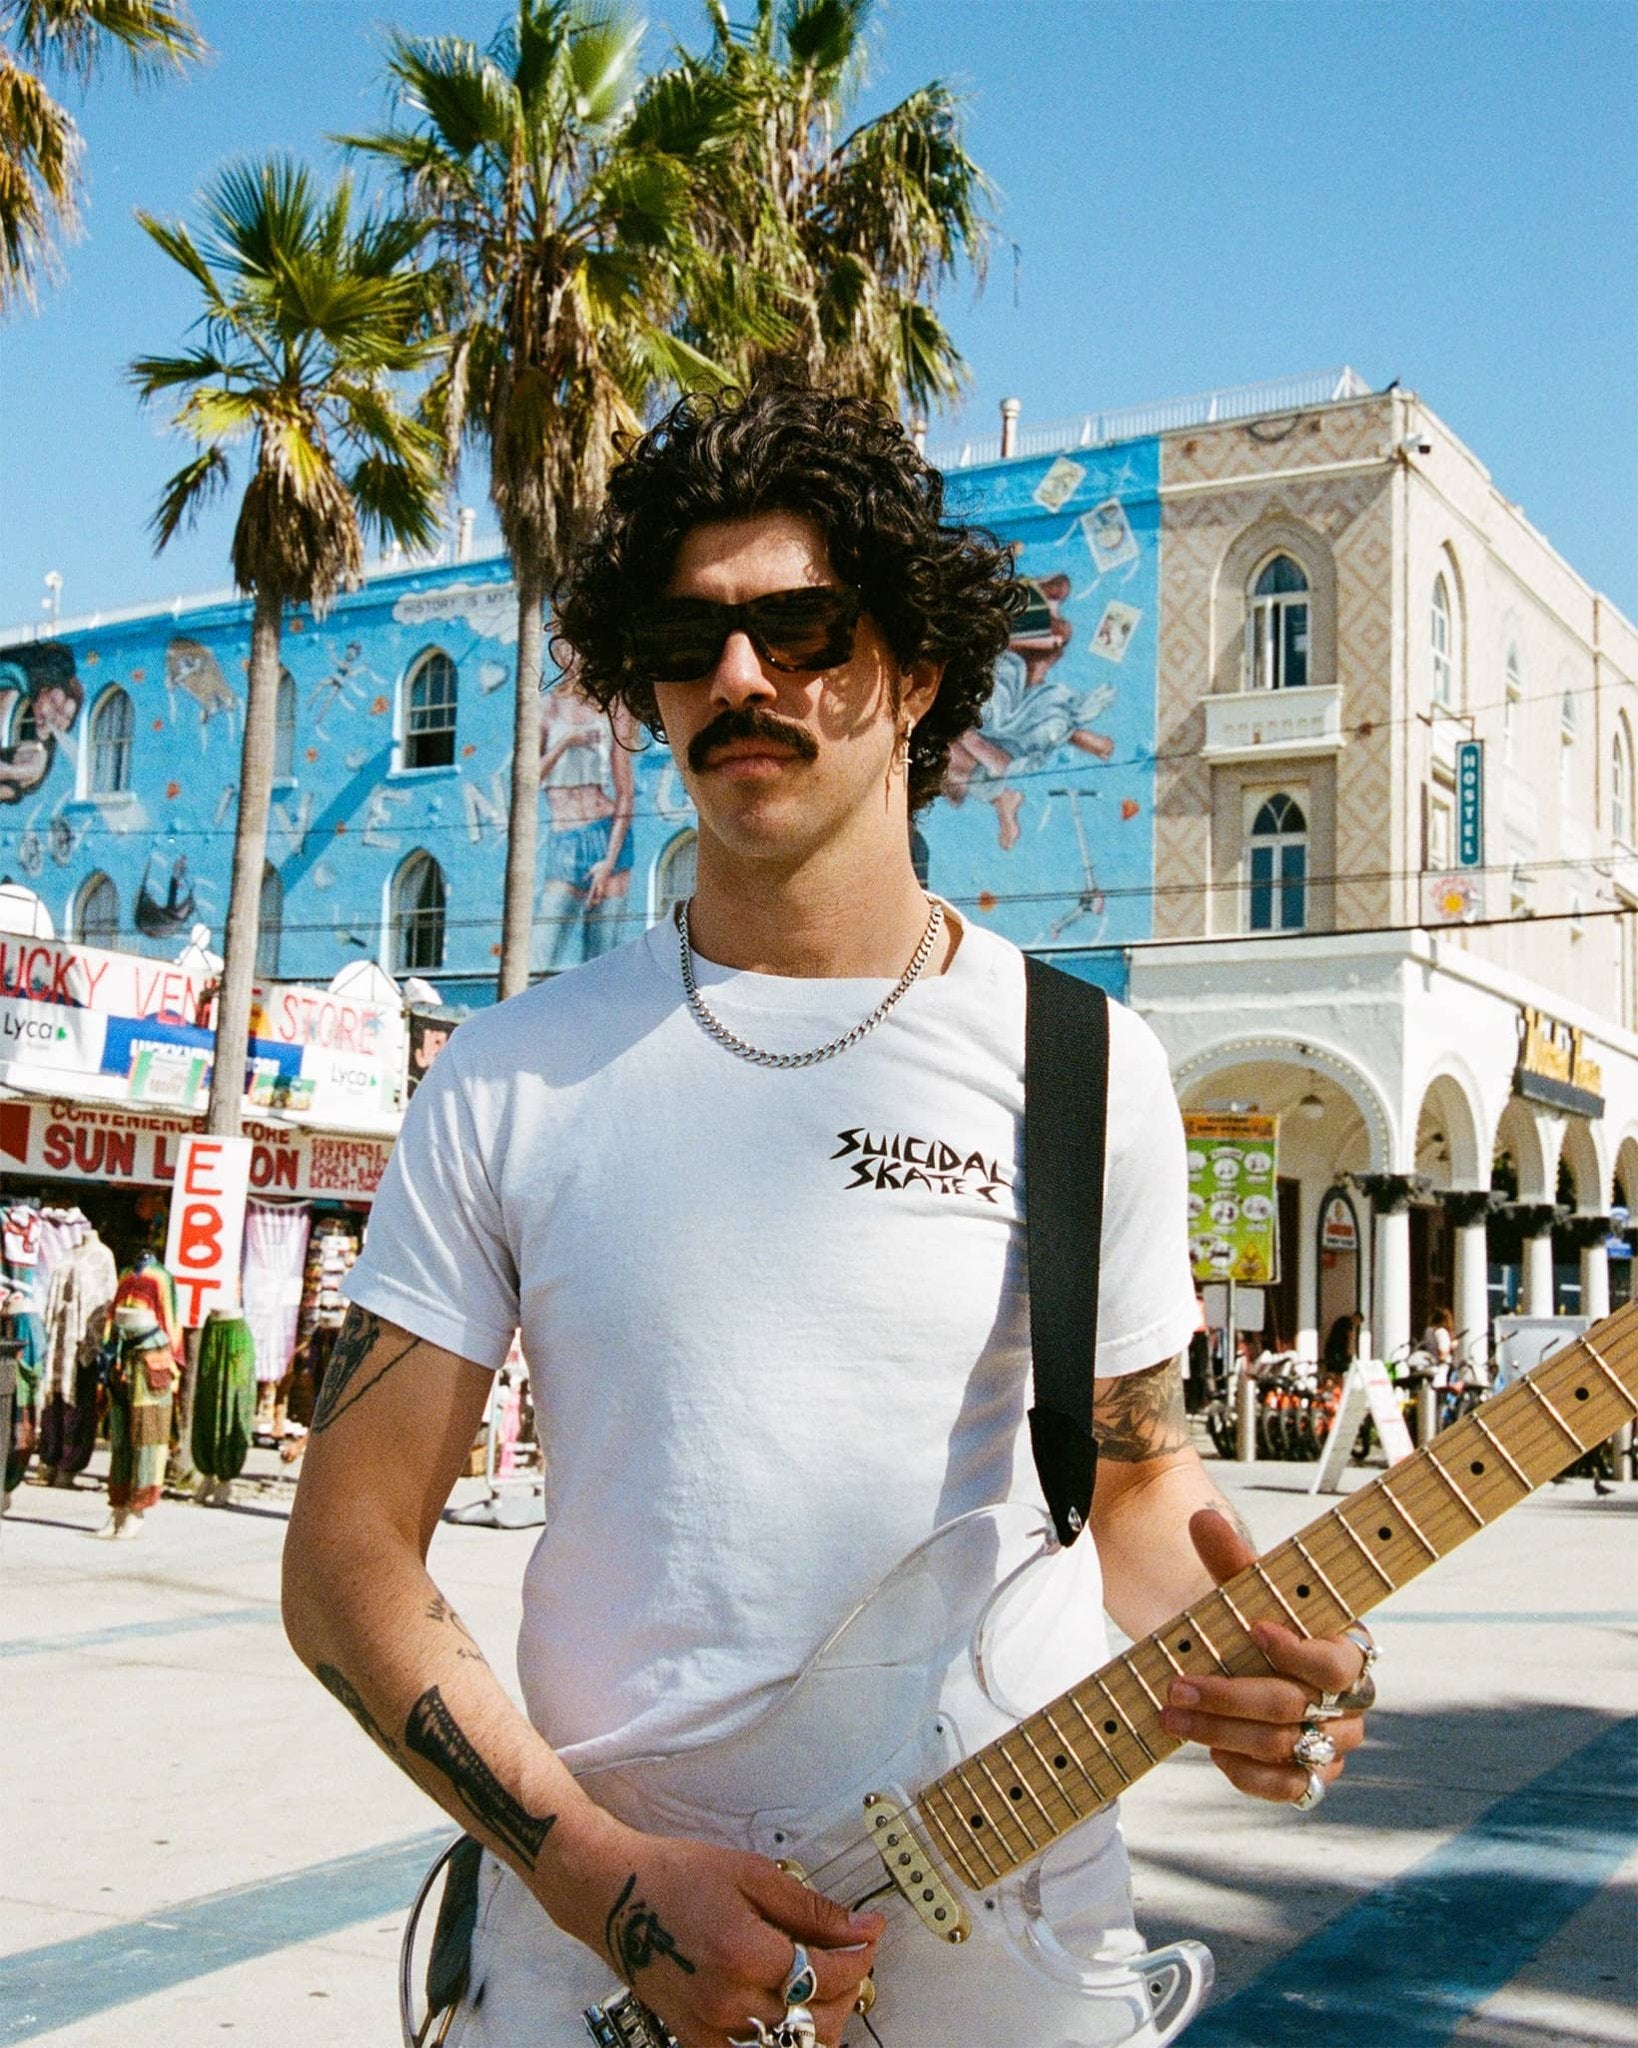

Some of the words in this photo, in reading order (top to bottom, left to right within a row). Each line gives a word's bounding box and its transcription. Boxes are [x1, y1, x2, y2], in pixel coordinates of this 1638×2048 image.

[1462, 753, 1476, 855] HOSTEL
[4, 1012, 53, 1040] Lyca
[279, 993, 377, 1056] STORE
[330, 1062, 368, 1087] Lyca
[43, 1123, 137, 1176] SUN
[829, 1127, 1015, 1190] SUICIDAL
[844, 1157, 1000, 1204] SKATES
[174, 1141, 223, 1328] EBT
